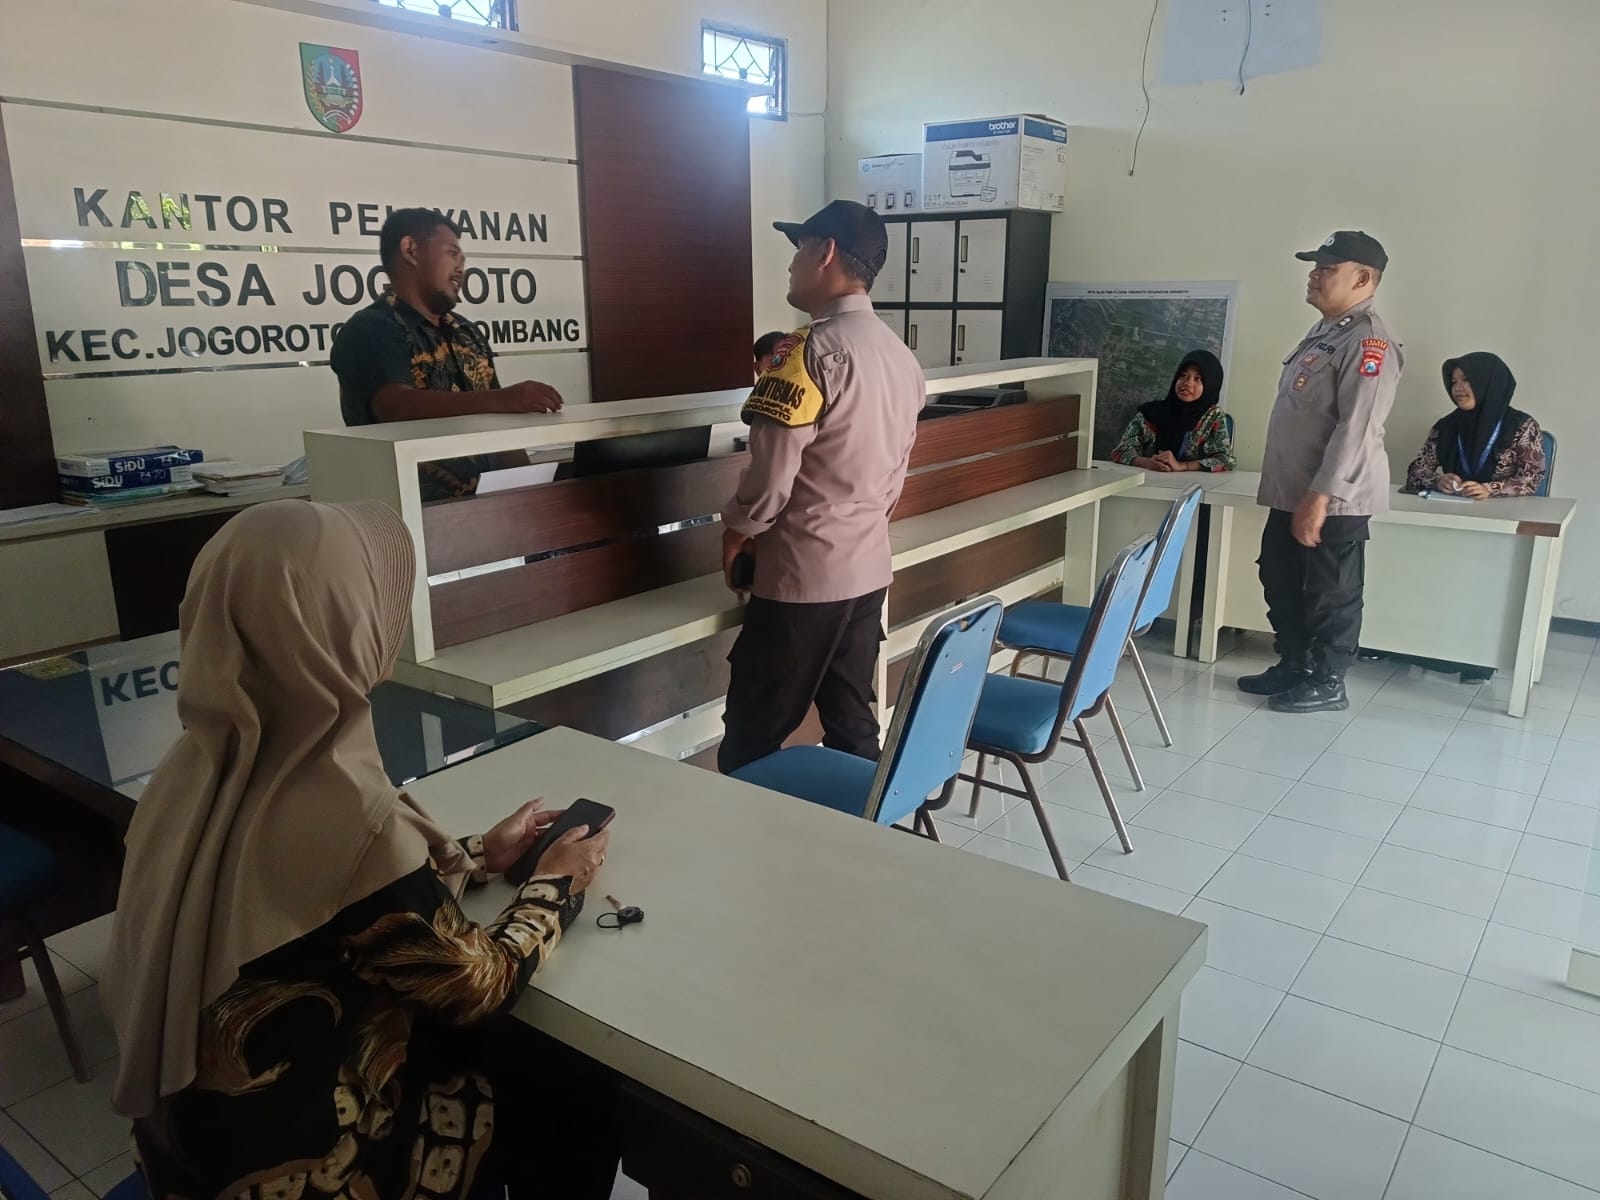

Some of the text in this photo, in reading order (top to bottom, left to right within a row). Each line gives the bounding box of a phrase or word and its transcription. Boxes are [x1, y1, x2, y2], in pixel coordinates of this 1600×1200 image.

[988, 121, 1017, 131] brother
[73, 187, 548, 243] KANTOR PEANAN
[115, 260, 537, 307] DESA JOGOTO
